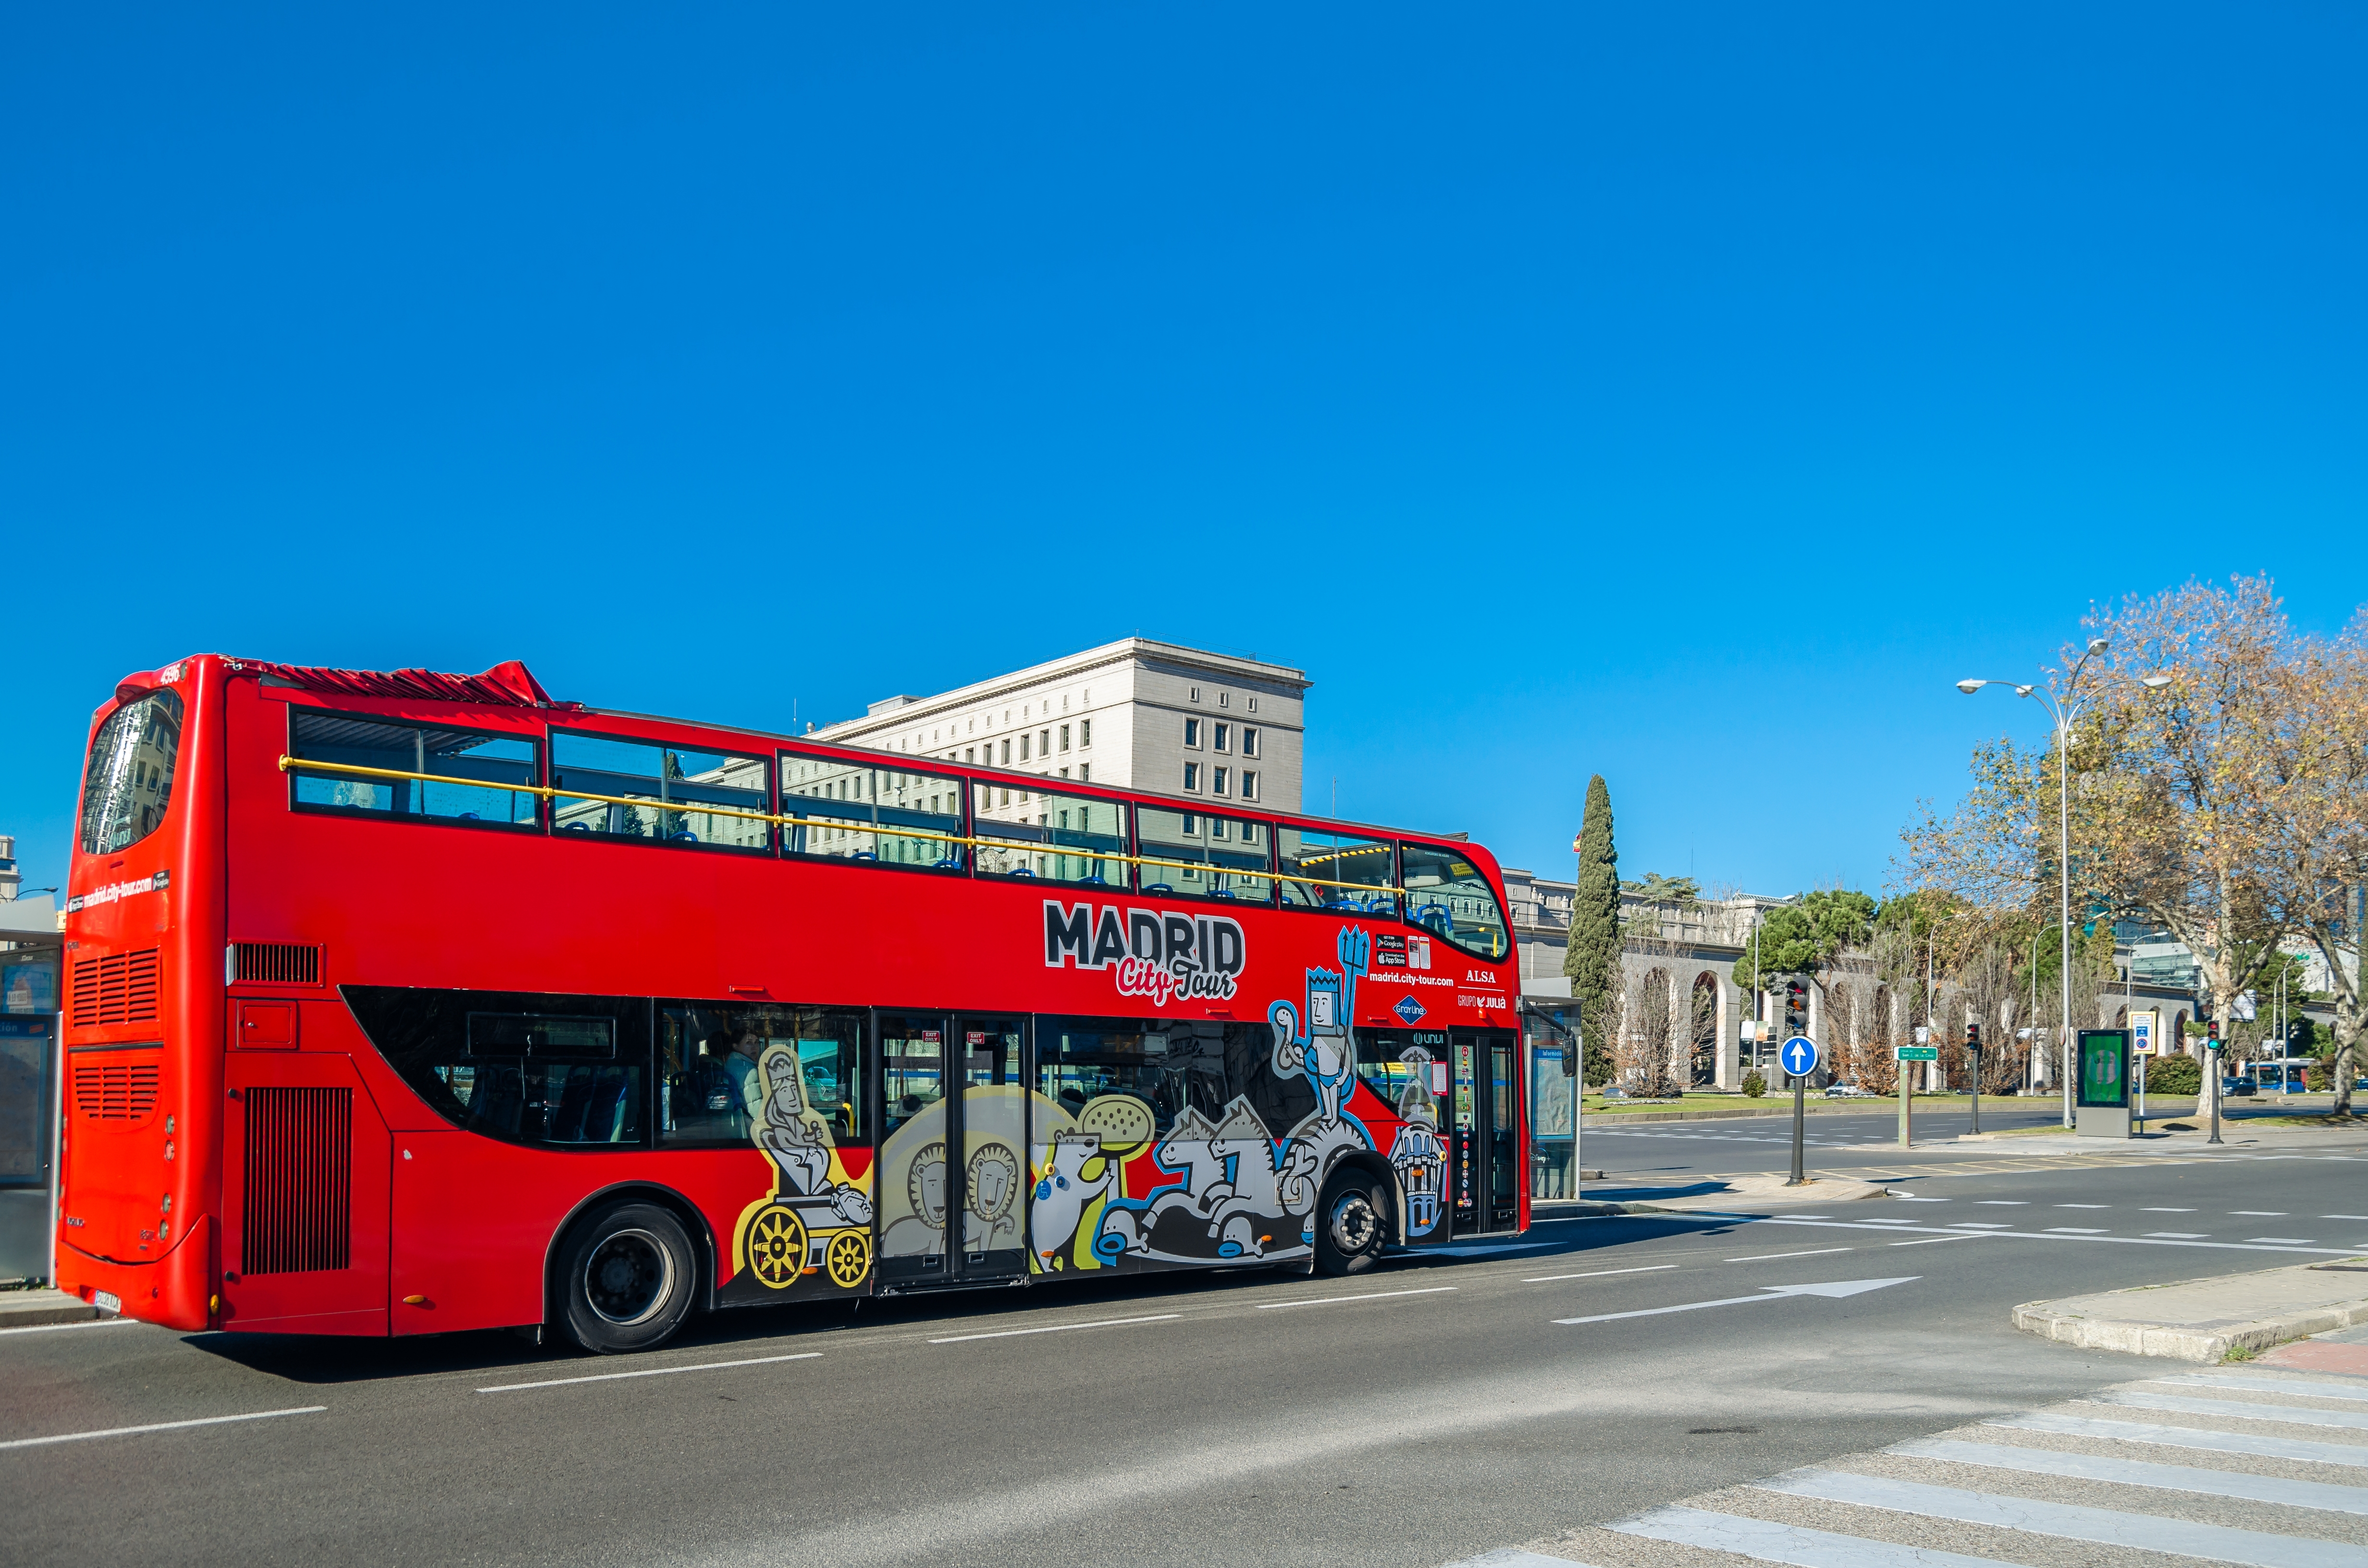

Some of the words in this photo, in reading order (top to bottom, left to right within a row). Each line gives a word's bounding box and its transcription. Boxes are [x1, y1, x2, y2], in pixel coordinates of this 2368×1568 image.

[160, 663, 181, 686] 4596
[84, 877, 152, 908] madrid.city-tour.com
[1045, 902, 1244, 977] MADRID
[1384, 940, 1396, 948] Google
[1385, 956, 1394, 965] App
[1118, 956, 1173, 1004] City
[1172, 959, 1235, 997] Tour
[1369, 972, 1454, 987] madrid.city-tour.com
[1466, 969, 1496, 983] ALSA
[1458, 994, 1476, 1007] GRUPO
[0, 1022, 18, 1032] ión
